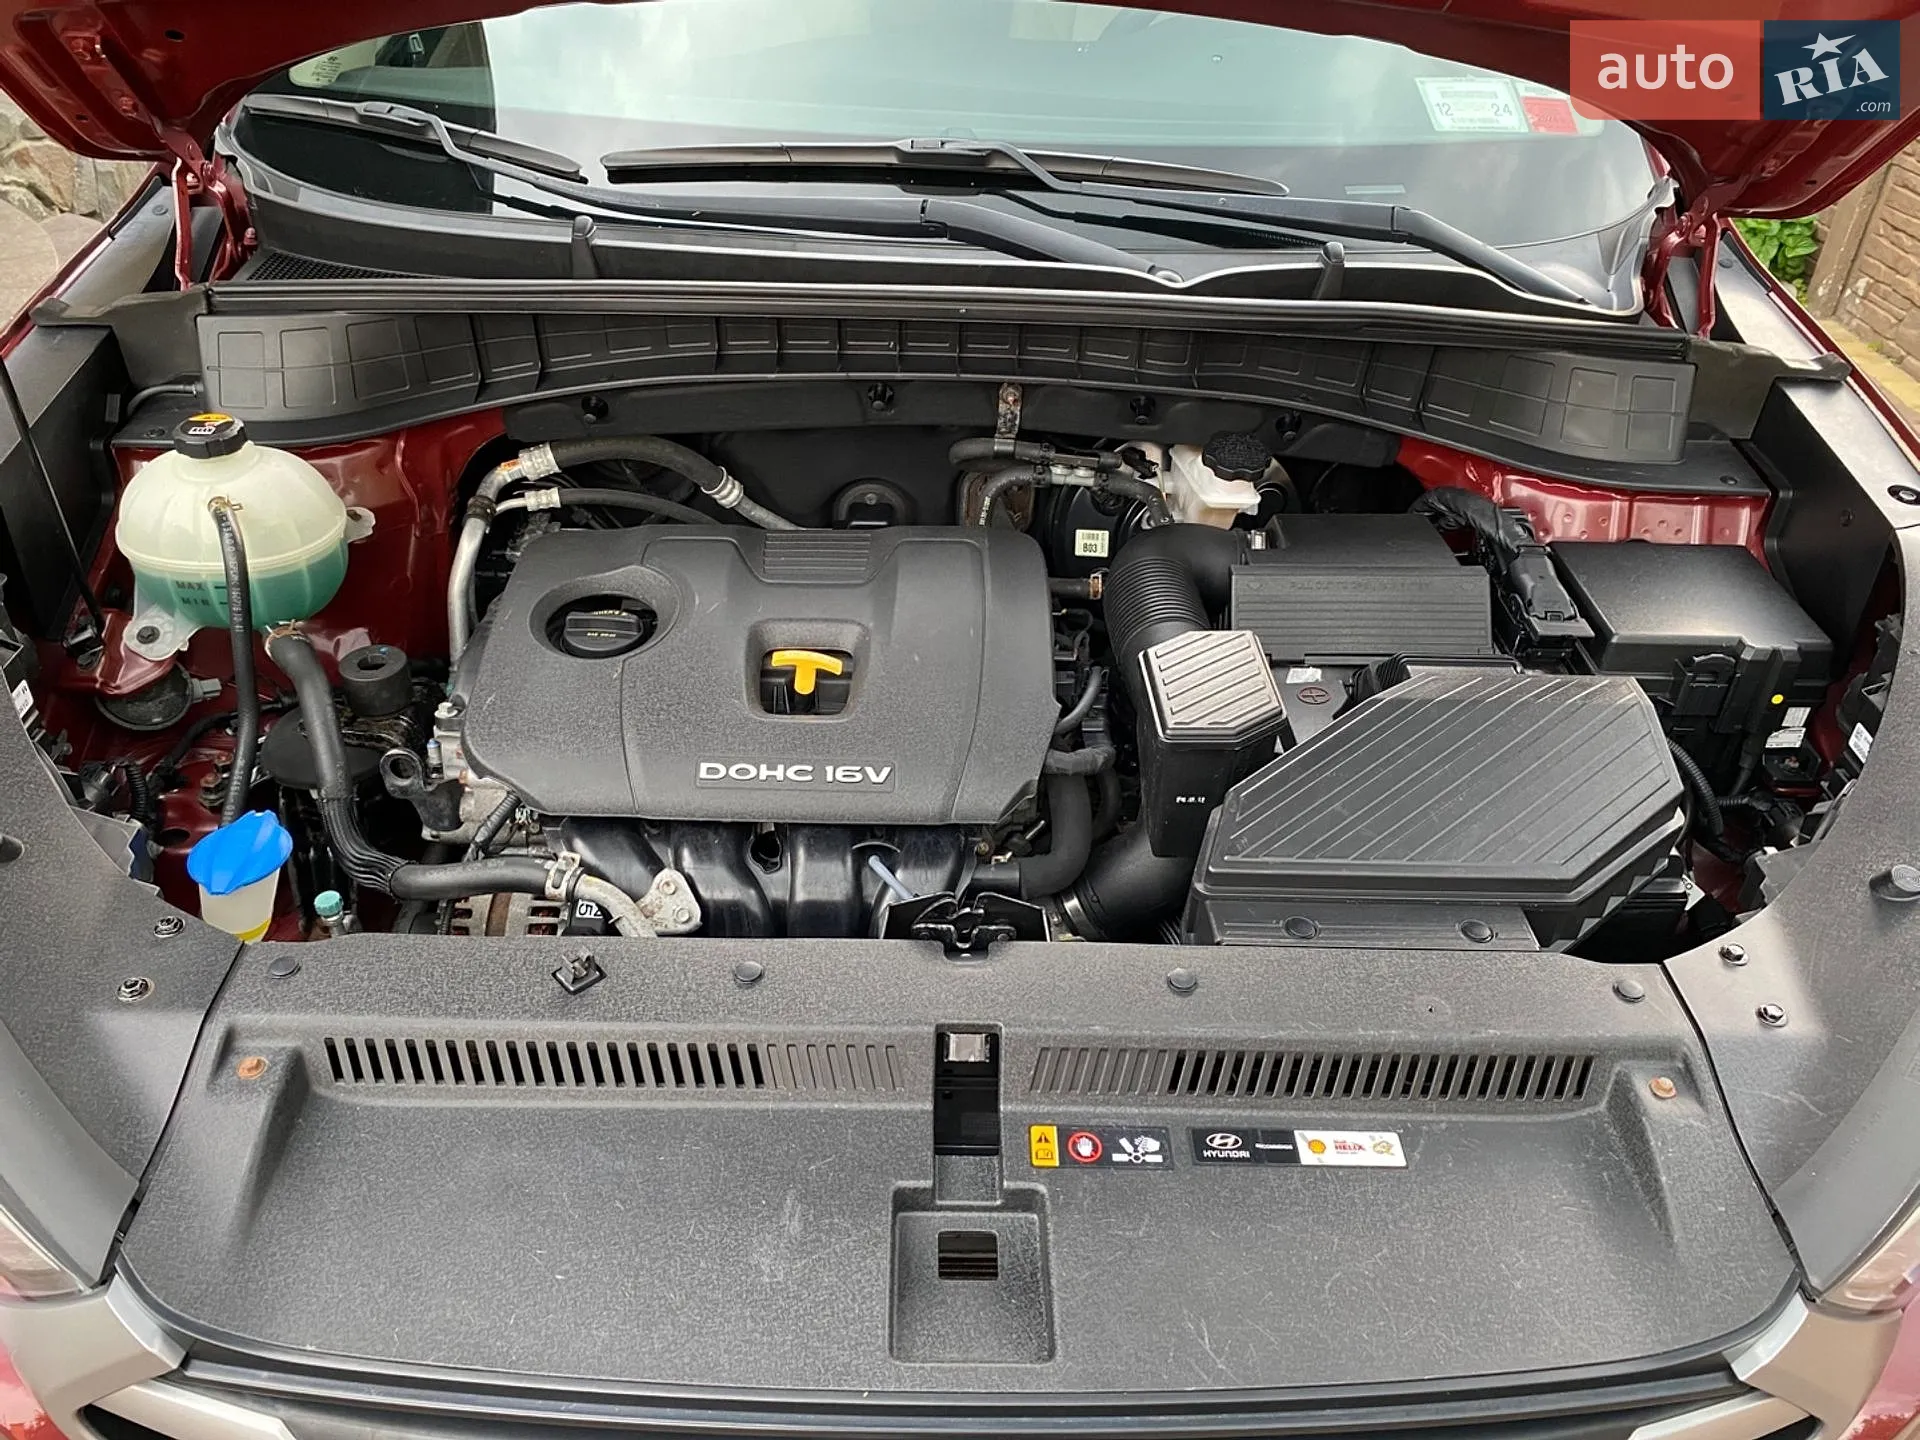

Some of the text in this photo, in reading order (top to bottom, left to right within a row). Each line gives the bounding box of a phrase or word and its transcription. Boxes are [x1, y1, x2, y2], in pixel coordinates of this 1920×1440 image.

[1435, 102, 1453, 117] 12
[1491, 102, 1513, 117] 24
[175, 581, 205, 591] MAX
[181, 597, 210, 606] MIN
[699, 762, 892, 784] DOHC 16V
[1203, 1149, 1250, 1159] HYUNDAI
